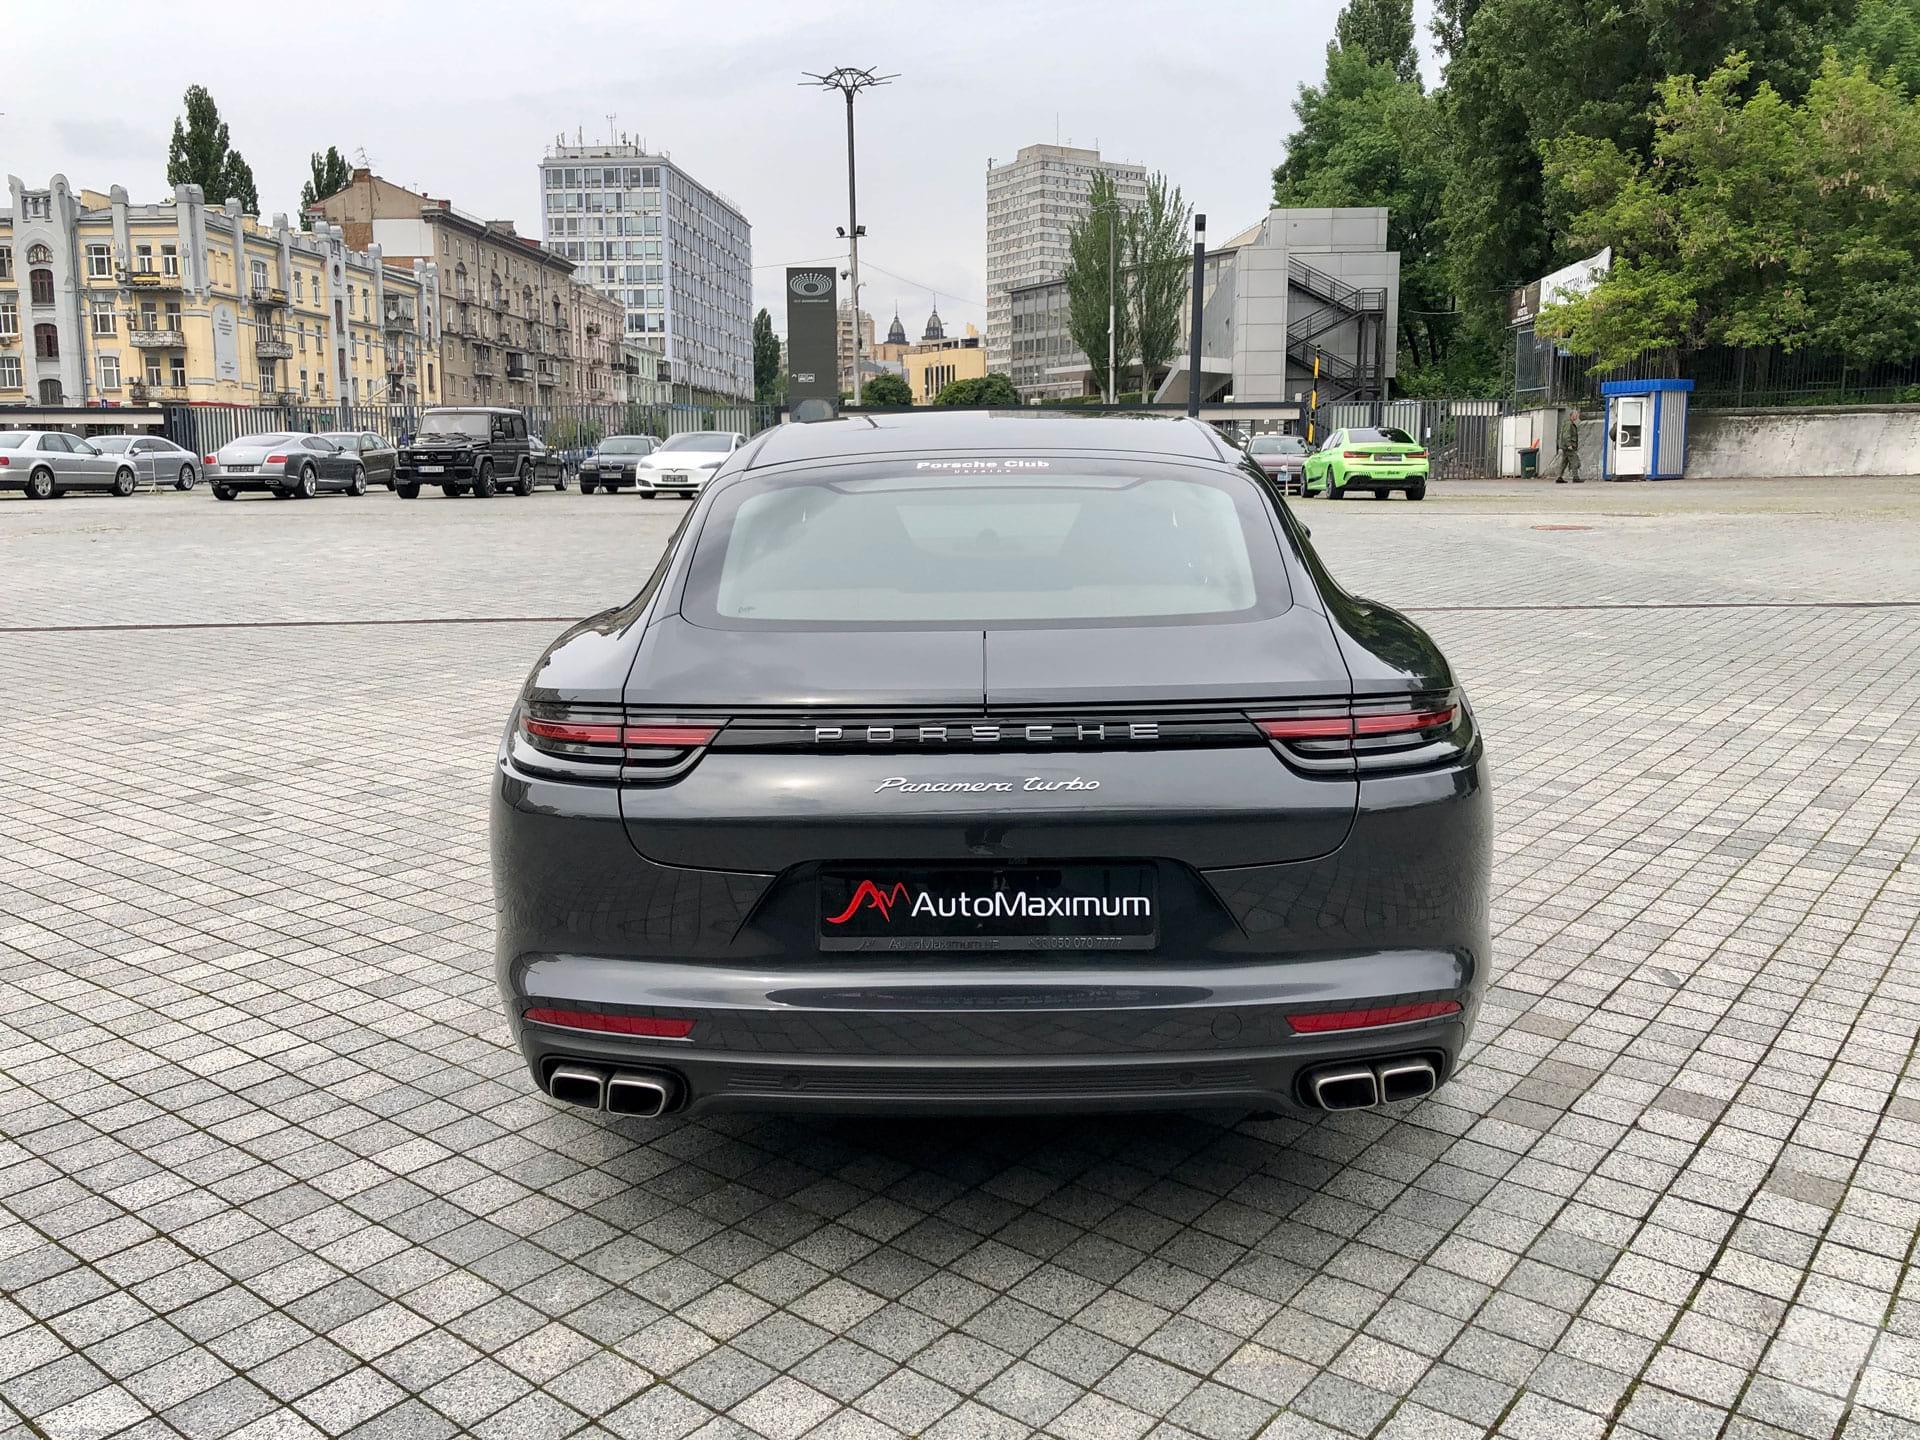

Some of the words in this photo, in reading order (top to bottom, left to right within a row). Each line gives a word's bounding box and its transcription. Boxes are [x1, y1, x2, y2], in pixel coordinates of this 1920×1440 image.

[916, 460, 998, 469] Porsche
[1003, 459, 1050, 468] Club
[814, 723, 1159, 744] PORSCHE
[873, 776, 1014, 794] Panamera
[1023, 776, 1101, 792] turbo
[911, 891, 1151, 918] AutoMaximum
[1051, 937, 1071, 948] 050
[1073, 937, 1094, 948] 070
[1096, 937, 1122, 948] 7777
